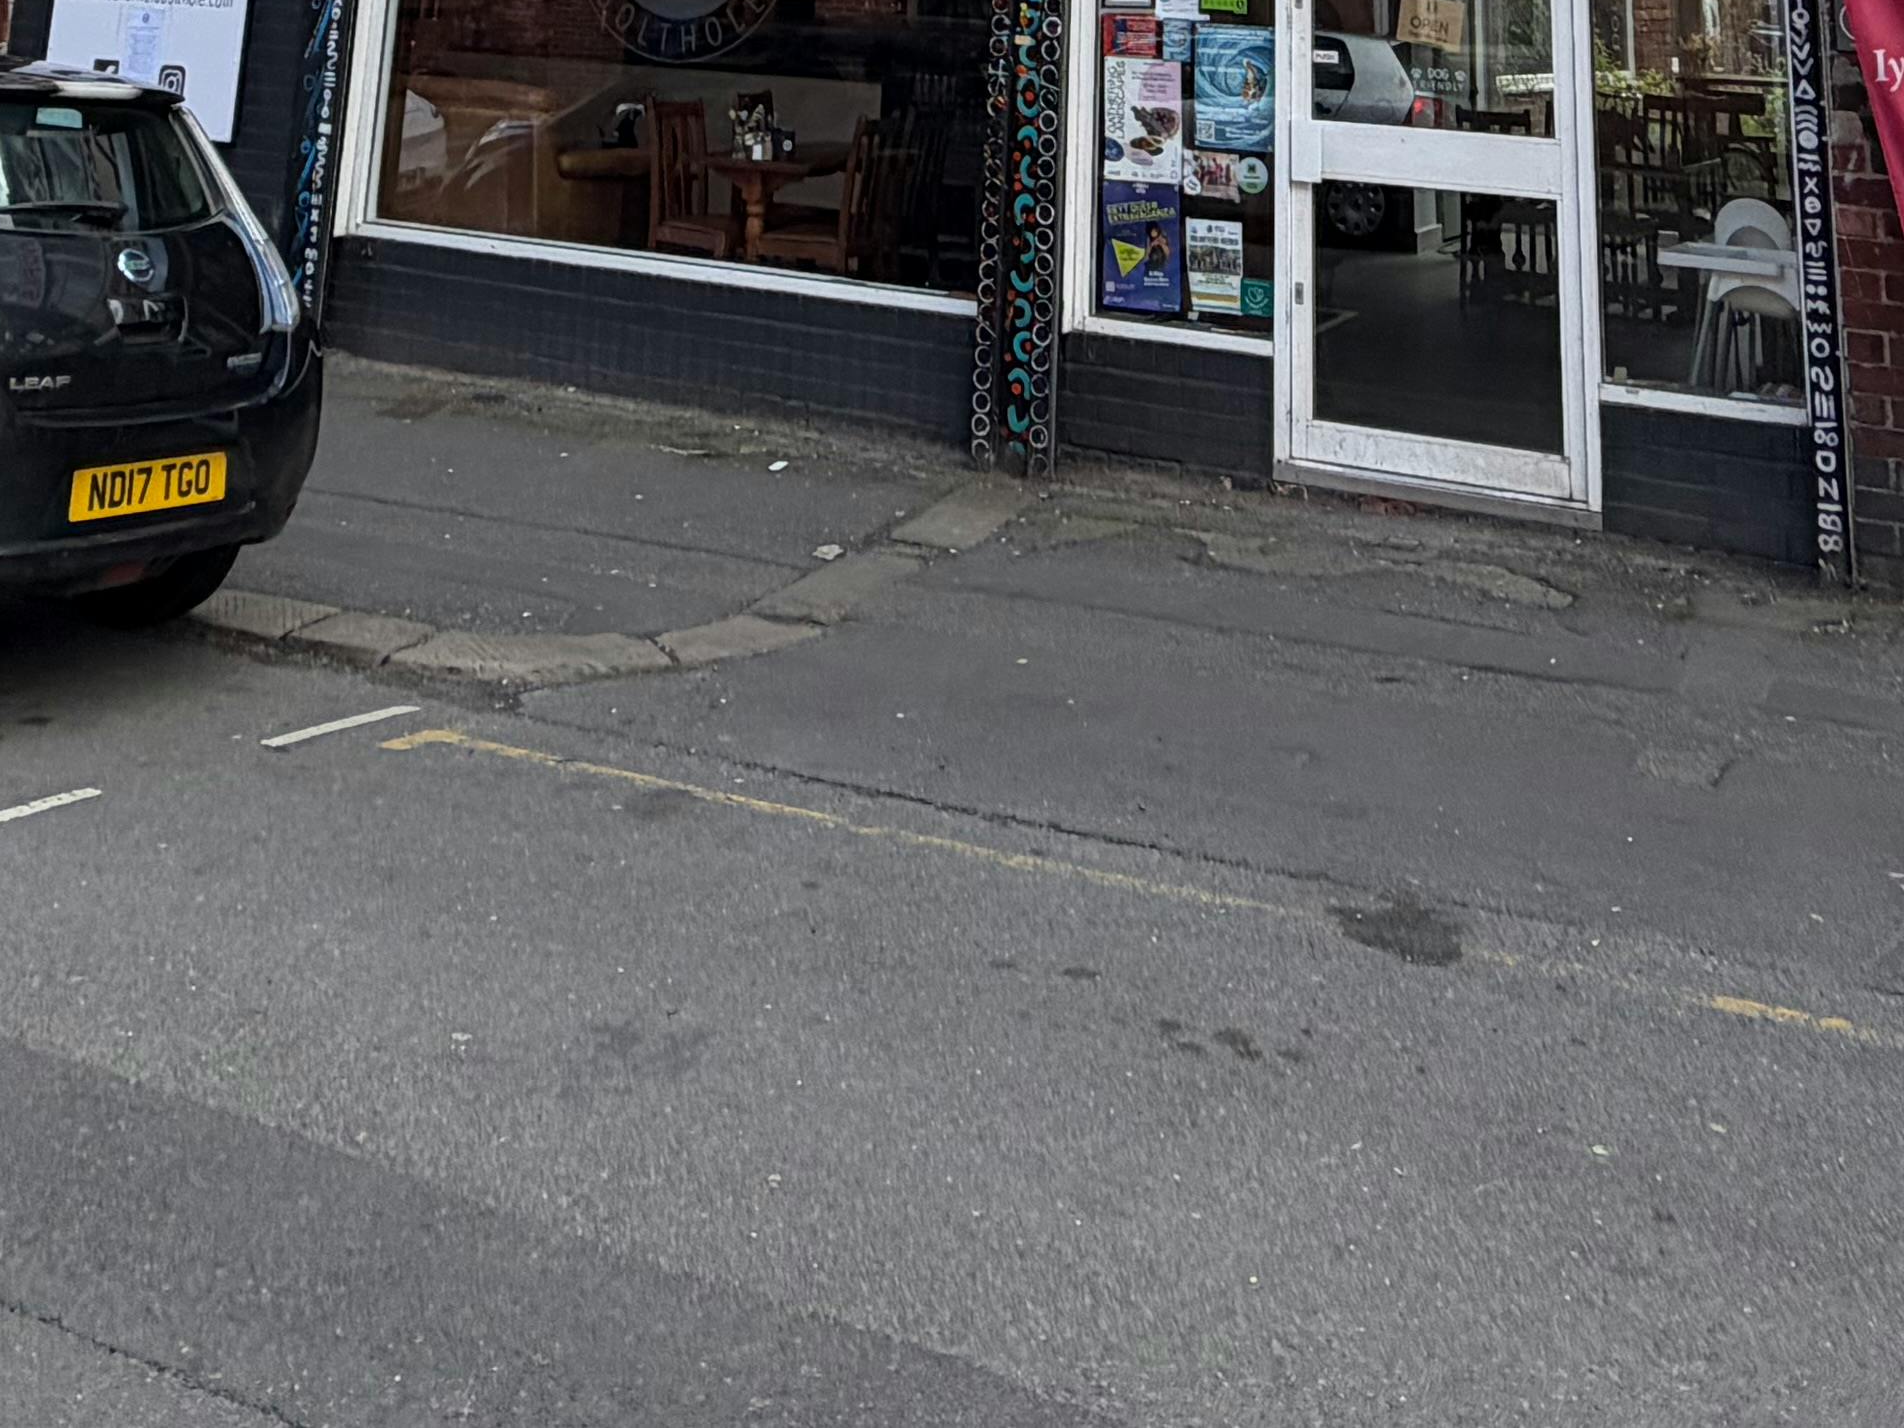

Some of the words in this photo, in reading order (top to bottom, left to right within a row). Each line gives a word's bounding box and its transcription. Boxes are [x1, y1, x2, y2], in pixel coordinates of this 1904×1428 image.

[1410, 15, 1449, 37] OPEN
[1427, 67, 1449, 80] DOG
[9, 375, 72, 392] LEAF
[87, 467, 153, 512] ND17
[161, 458, 211, 500] TGO
